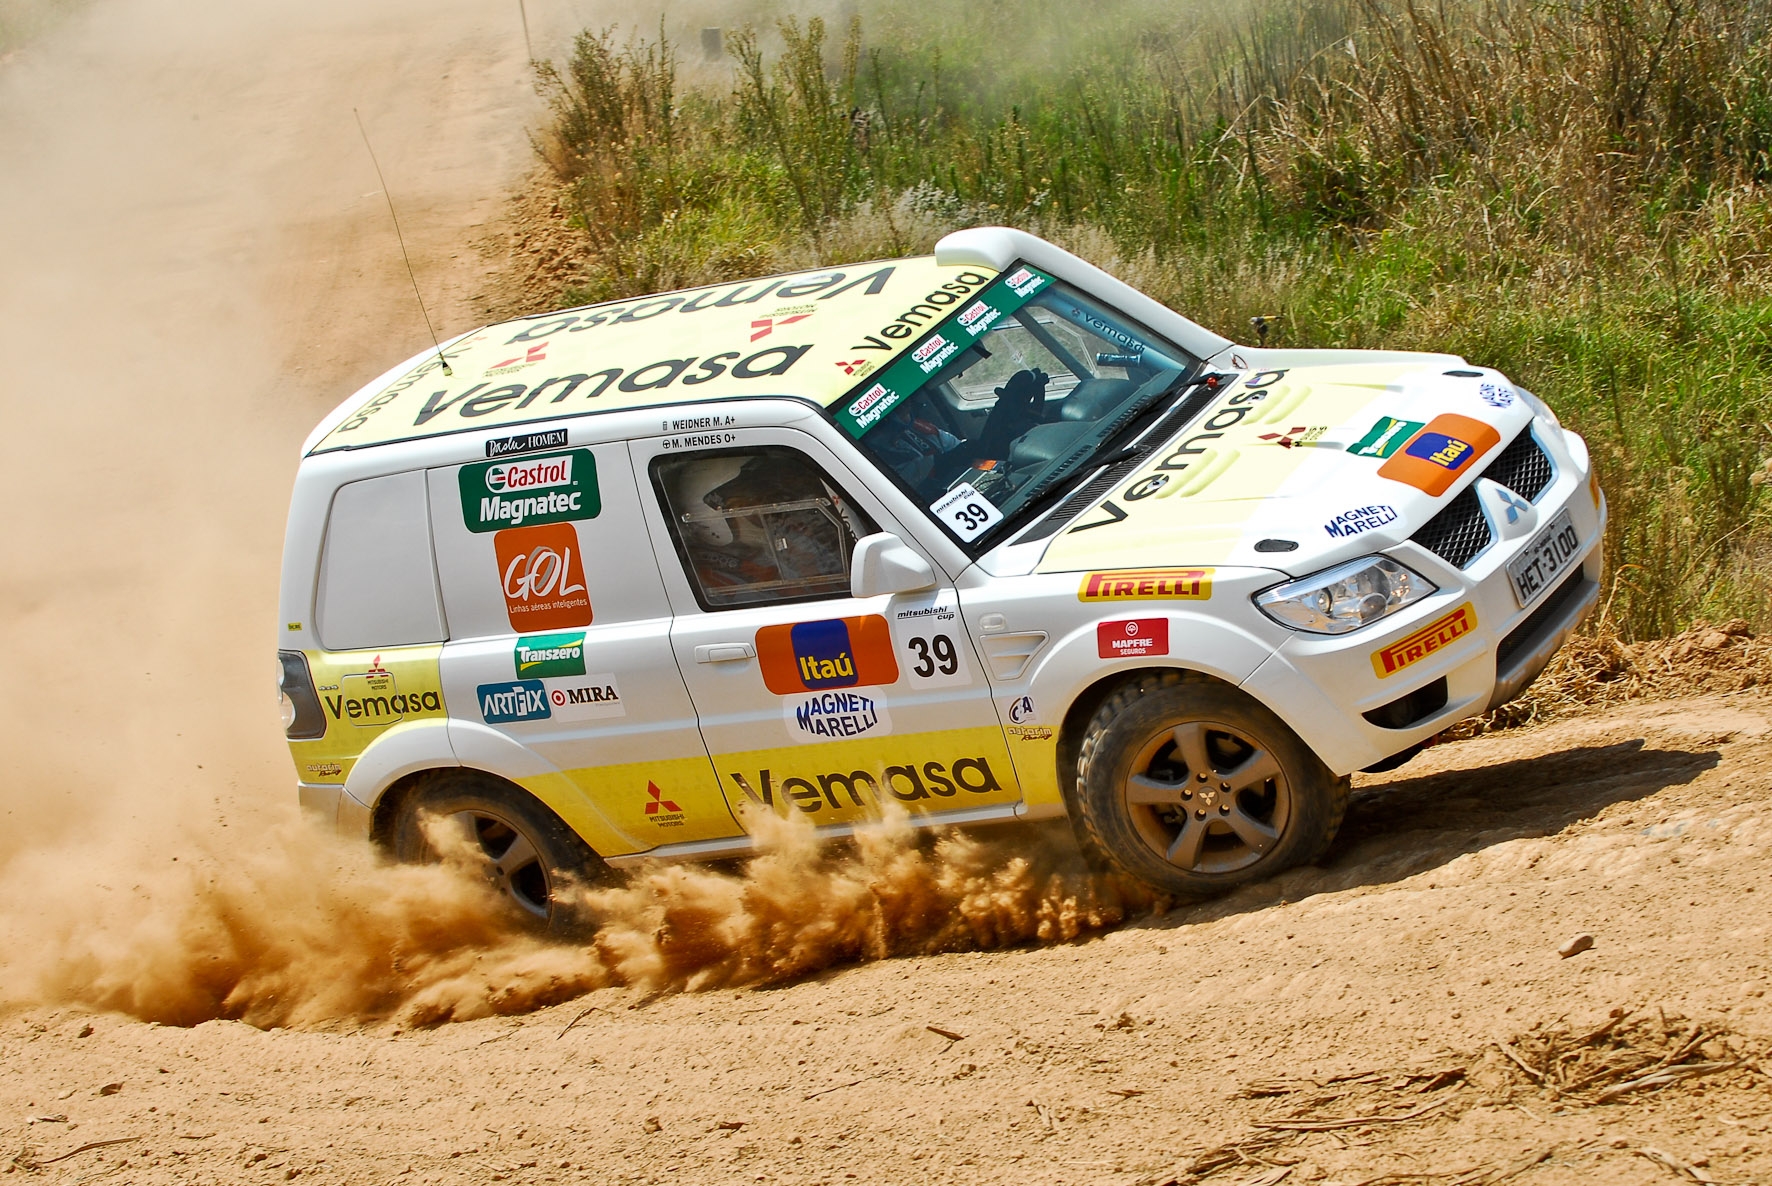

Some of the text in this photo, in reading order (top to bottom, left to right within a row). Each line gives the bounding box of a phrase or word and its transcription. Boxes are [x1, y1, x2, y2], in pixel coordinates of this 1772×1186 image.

[504, 267, 896, 345] Vemasa
[850, 270, 989, 352] Vemasa
[964, 302, 989, 322] Castrol
[965, 305, 1002, 338] Magnatec
[919, 337, 944, 358] Castrol
[919, 341, 960, 375] Magnatec
[413, 343, 815, 427] Vemasa
[857, 386, 884, 410] Castrol
[672, 415, 736, 430] WEIDNER M. A+
[855, 390, 900, 429] Magnatec
[528, 431, 566, 449] HOMEM
[672, 438, 683, 449] M.
[684, 434, 722, 448] MENDES
[1066, 368, 1291, 535] Vemasa
[1429, 438, 1469, 466] Itaú
[507, 460, 567, 489] Castrol
[480, 492, 582, 526] Magnatec
[955, 503, 989, 531] 39
[1324, 505, 1398, 533] MAGNETI
[1325, 508, 1399, 538] MARELLI
[504, 545, 586, 602] GOL
[1086, 570, 1206, 598] PIRELLI
[509, 598, 588, 614] Linhas aéreas inteligentes
[897, 606, 948, 619] mitsubishi
[937, 612, 955, 621] cup
[516, 646, 581, 664] Transzero
[1112, 638, 1154, 649] MAPFRE
[1120, 647, 1147, 656] SEGUROS
[1380, 608, 1469, 674] PIRELLI
[800, 652, 854, 681] Itaú
[908, 634, 959, 678] 39
[325, 691, 442, 720] Vemasa
[484, 686, 546, 717] ARTFIX
[567, 685, 620, 704] MIRA
[796, 692, 876, 718] MAGNETI
[797, 713, 879, 738] MARELLI
[730, 754, 1002, 813] Vemasa
